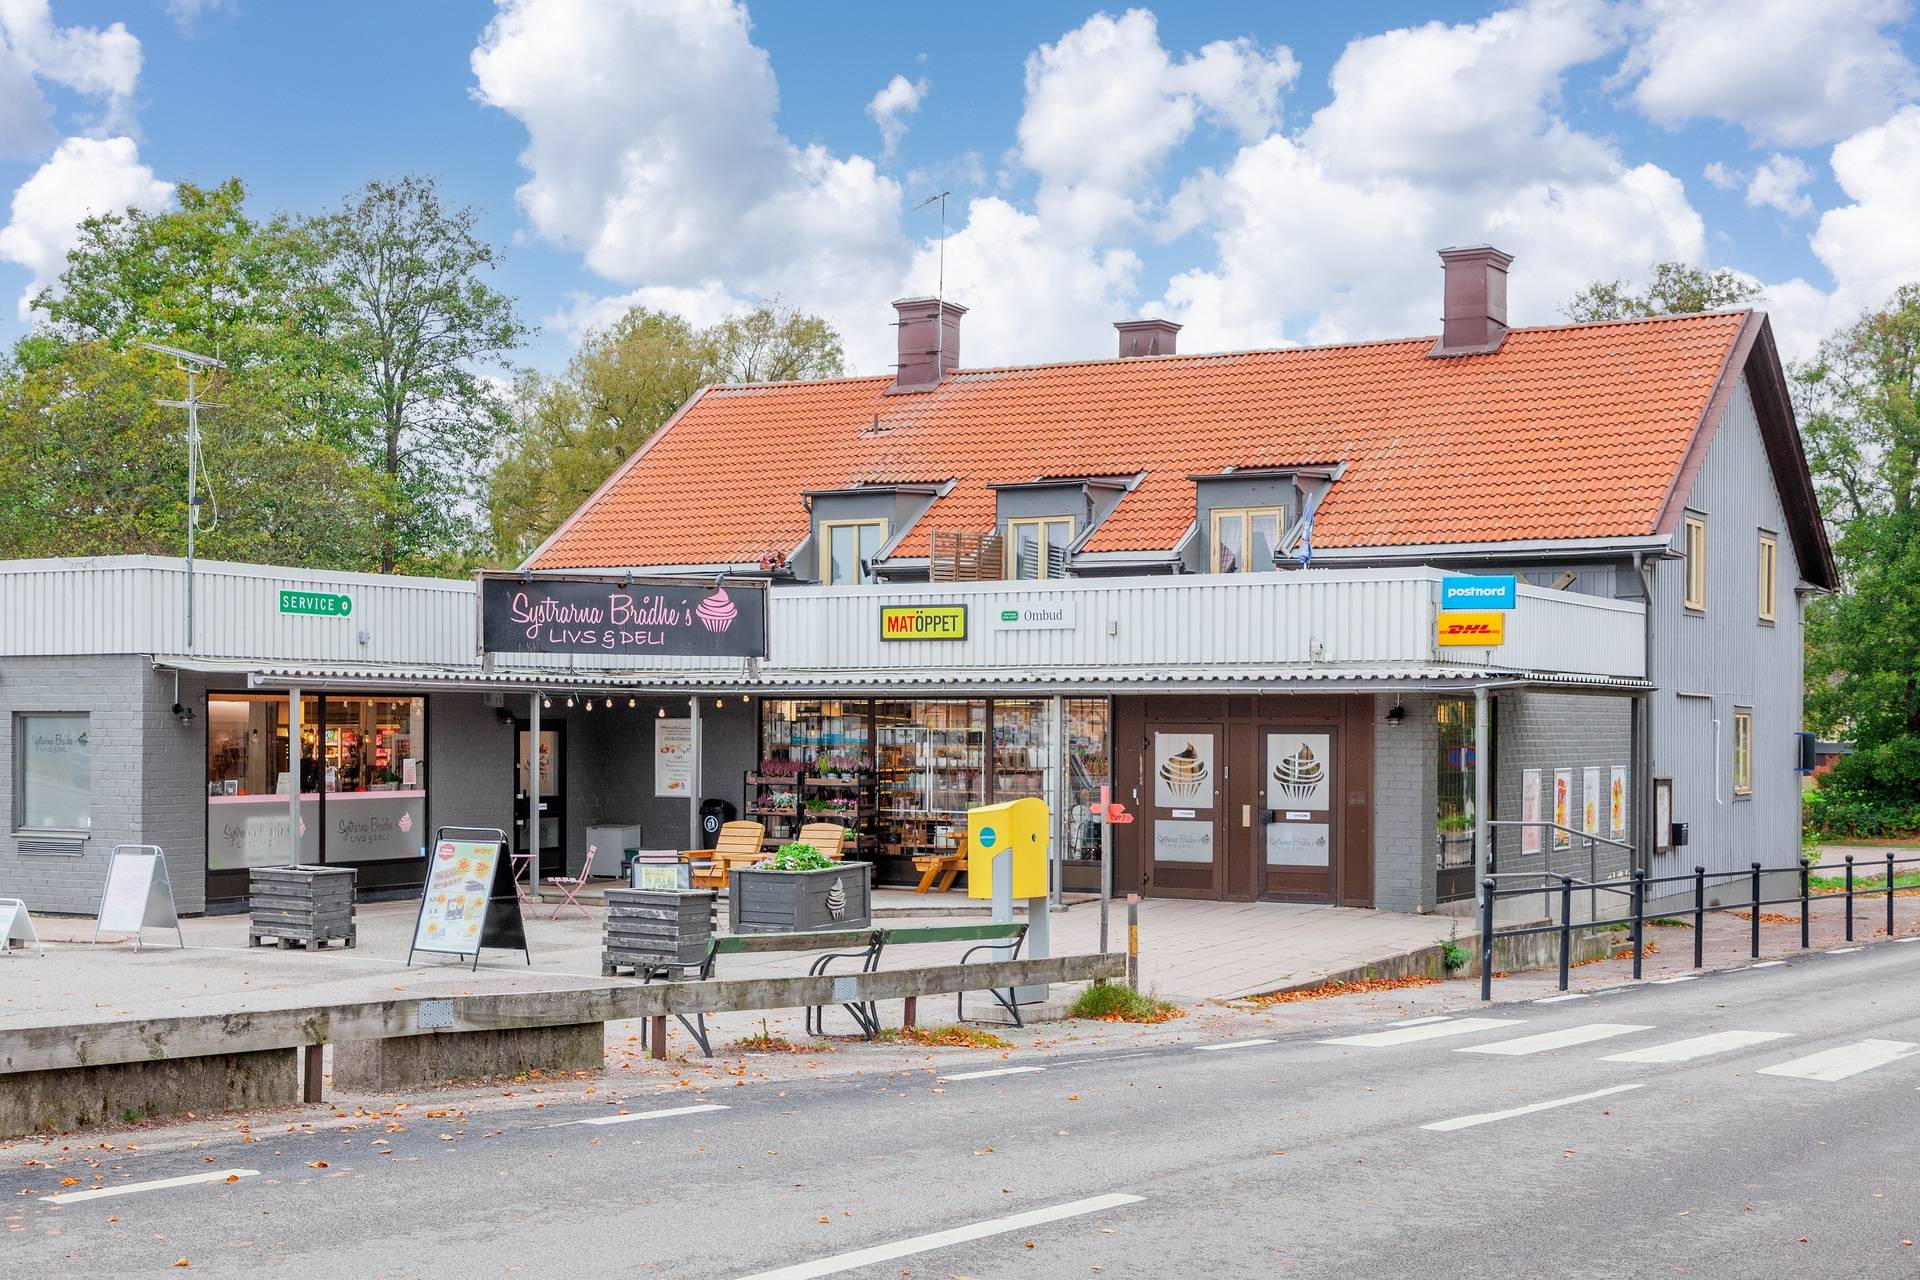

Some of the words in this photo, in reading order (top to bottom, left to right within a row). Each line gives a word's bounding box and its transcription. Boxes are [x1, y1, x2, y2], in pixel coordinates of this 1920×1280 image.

[1448, 587, 1505, 598] postnord
[283, 596, 334, 611] SERVICE
[511, 592, 603, 639] Systrarna
[887, 611, 959, 632] MATÖPPET
[1024, 609, 1063, 621] Ombud
[1448, 625, 1491, 634] DHL
[550, 631, 596, 643] LIVS
[601, 631, 614, 649] &
[621, 632, 664, 645] DELI
